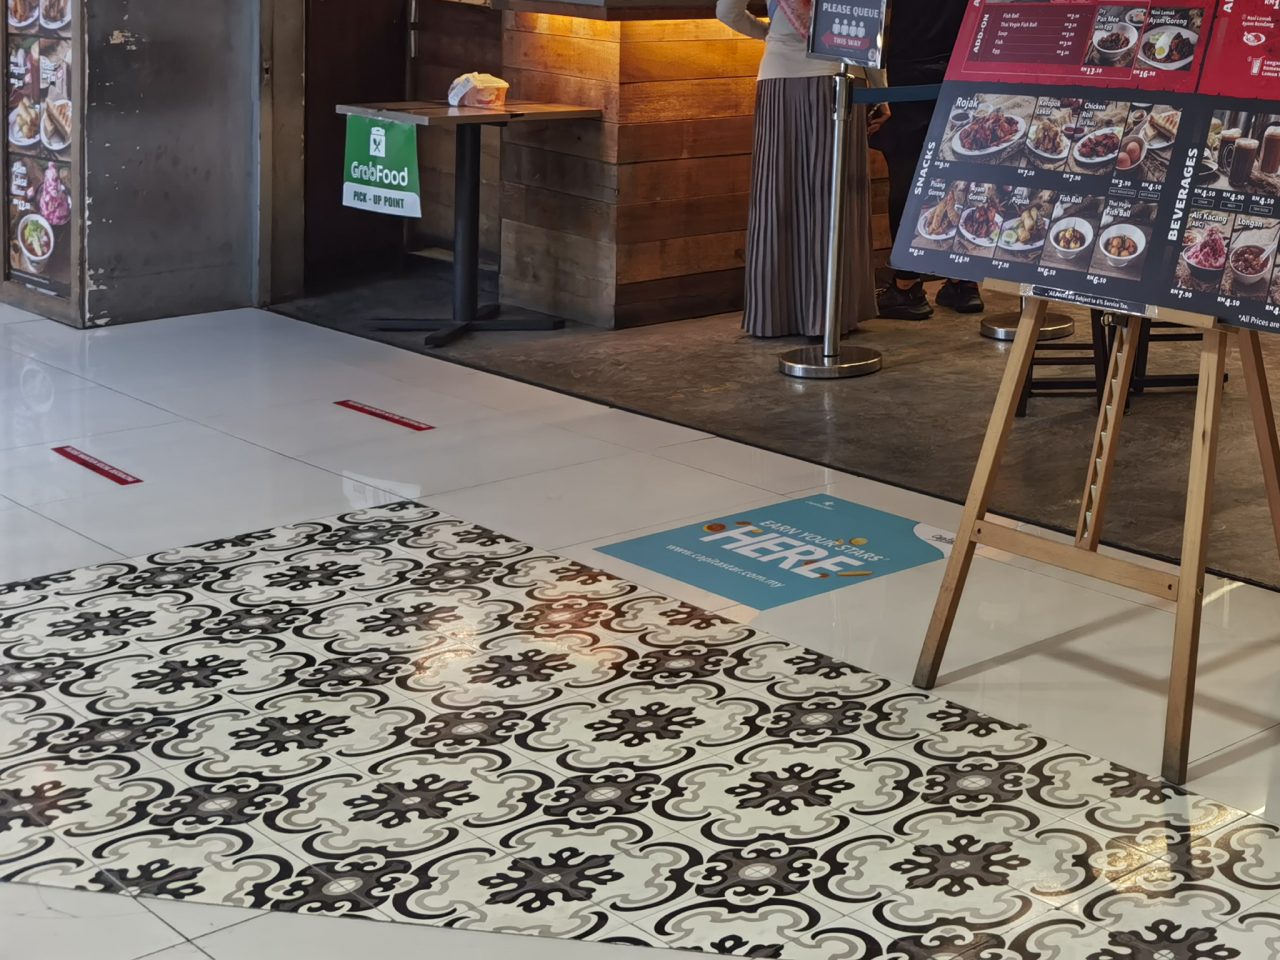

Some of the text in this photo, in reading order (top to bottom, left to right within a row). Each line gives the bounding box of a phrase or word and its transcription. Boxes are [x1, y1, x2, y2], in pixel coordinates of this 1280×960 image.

[822, 2, 880, 18] PLEASE QUEUE
[1148, 16, 1188, 26] Ayam Goreng
[973, 13, 990, 54] ADD-ON
[833, 37, 862, 47] THIS WAY
[955, 97, 980, 110] Rojak
[1038, 100, 1061, 108] Keropok
[1084, 102, 1106, 110] Chicken
[914, 141, 936, 195] SNACKS
[350, 161, 409, 187] GrabFood
[930, 181, 946, 189] Pisang
[1141, 181, 1162, 191] RM4.50
[928, 189, 946, 199] Goreng
[968, 193, 987, 203] Goreng
[1168, 148, 1198, 241] BEVERAGES
[1194, 188, 1216, 198] RM4.50
[1222, 191, 1245, 201] RM4.90
[353, 190, 368, 203] PICK
[373, 194, 382, 205] UP
[383, 196, 405, 209] POINT
[1011, 196, 1030, 205] Popiah
[1059, 194, 1083, 203] Fish Ball
[1251, 195, 1275, 205] RM4.50
[1106, 207, 1131, 217] Fish Ball
[1191, 211, 1228, 223] Ais Kacang
[1238, 217, 1263, 228] Longan
[1037, 266, 1056, 276] RM6.50
[1086, 274, 1107, 284] RM6.50
[1170, 288, 1193, 299] RM7.90
[1216, 296, 1241, 307] RM4.50
[1250, 316, 1269, 328] Prices
[1269, 320, 1280, 329] are
[760, 520, 801, 535] EARN
[799, 531, 836, 548] YOUR
[699, 524, 865, 579] HERE
[665, 544, 786, 588] www.capitastar.com.my
